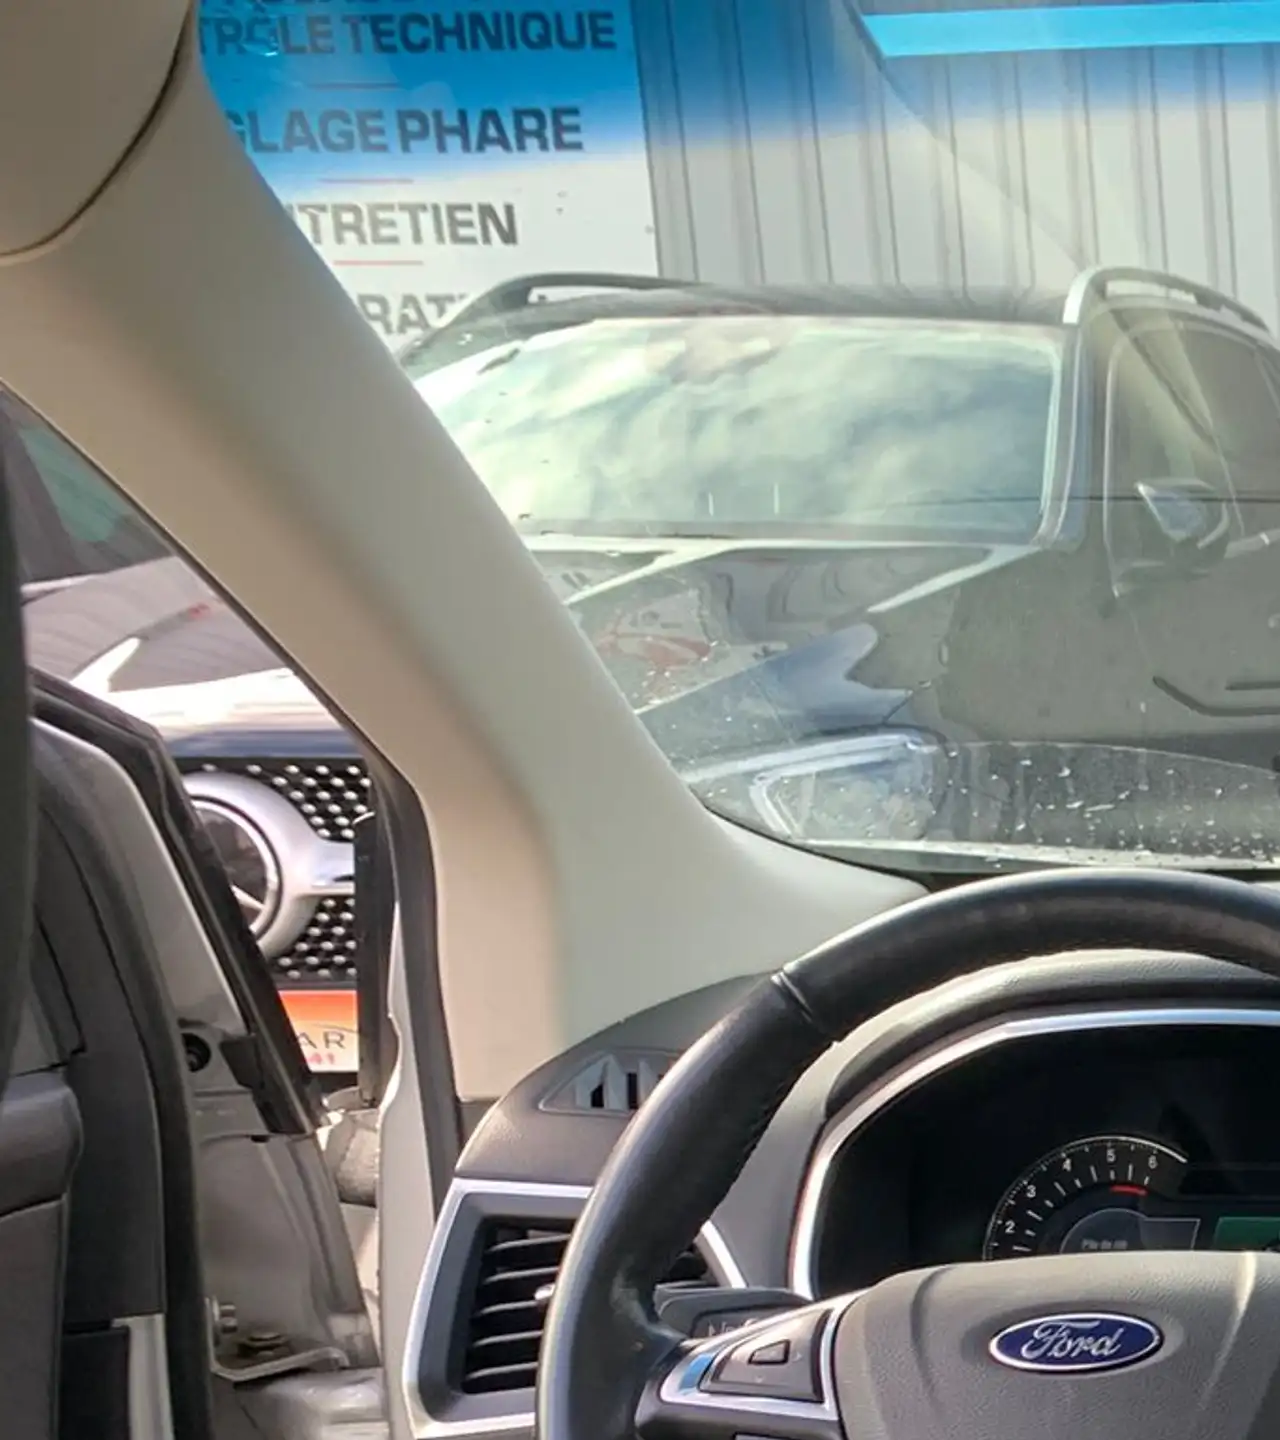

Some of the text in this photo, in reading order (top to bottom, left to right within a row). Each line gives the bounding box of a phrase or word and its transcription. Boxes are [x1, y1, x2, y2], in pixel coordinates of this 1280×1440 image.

[341, 10, 616, 54] TECHNIQUE
[398, 106, 583, 152] PHARE
[1004, 1220, 1016, 1235] 2
[1021, 1320, 1123, 1359] Ford
